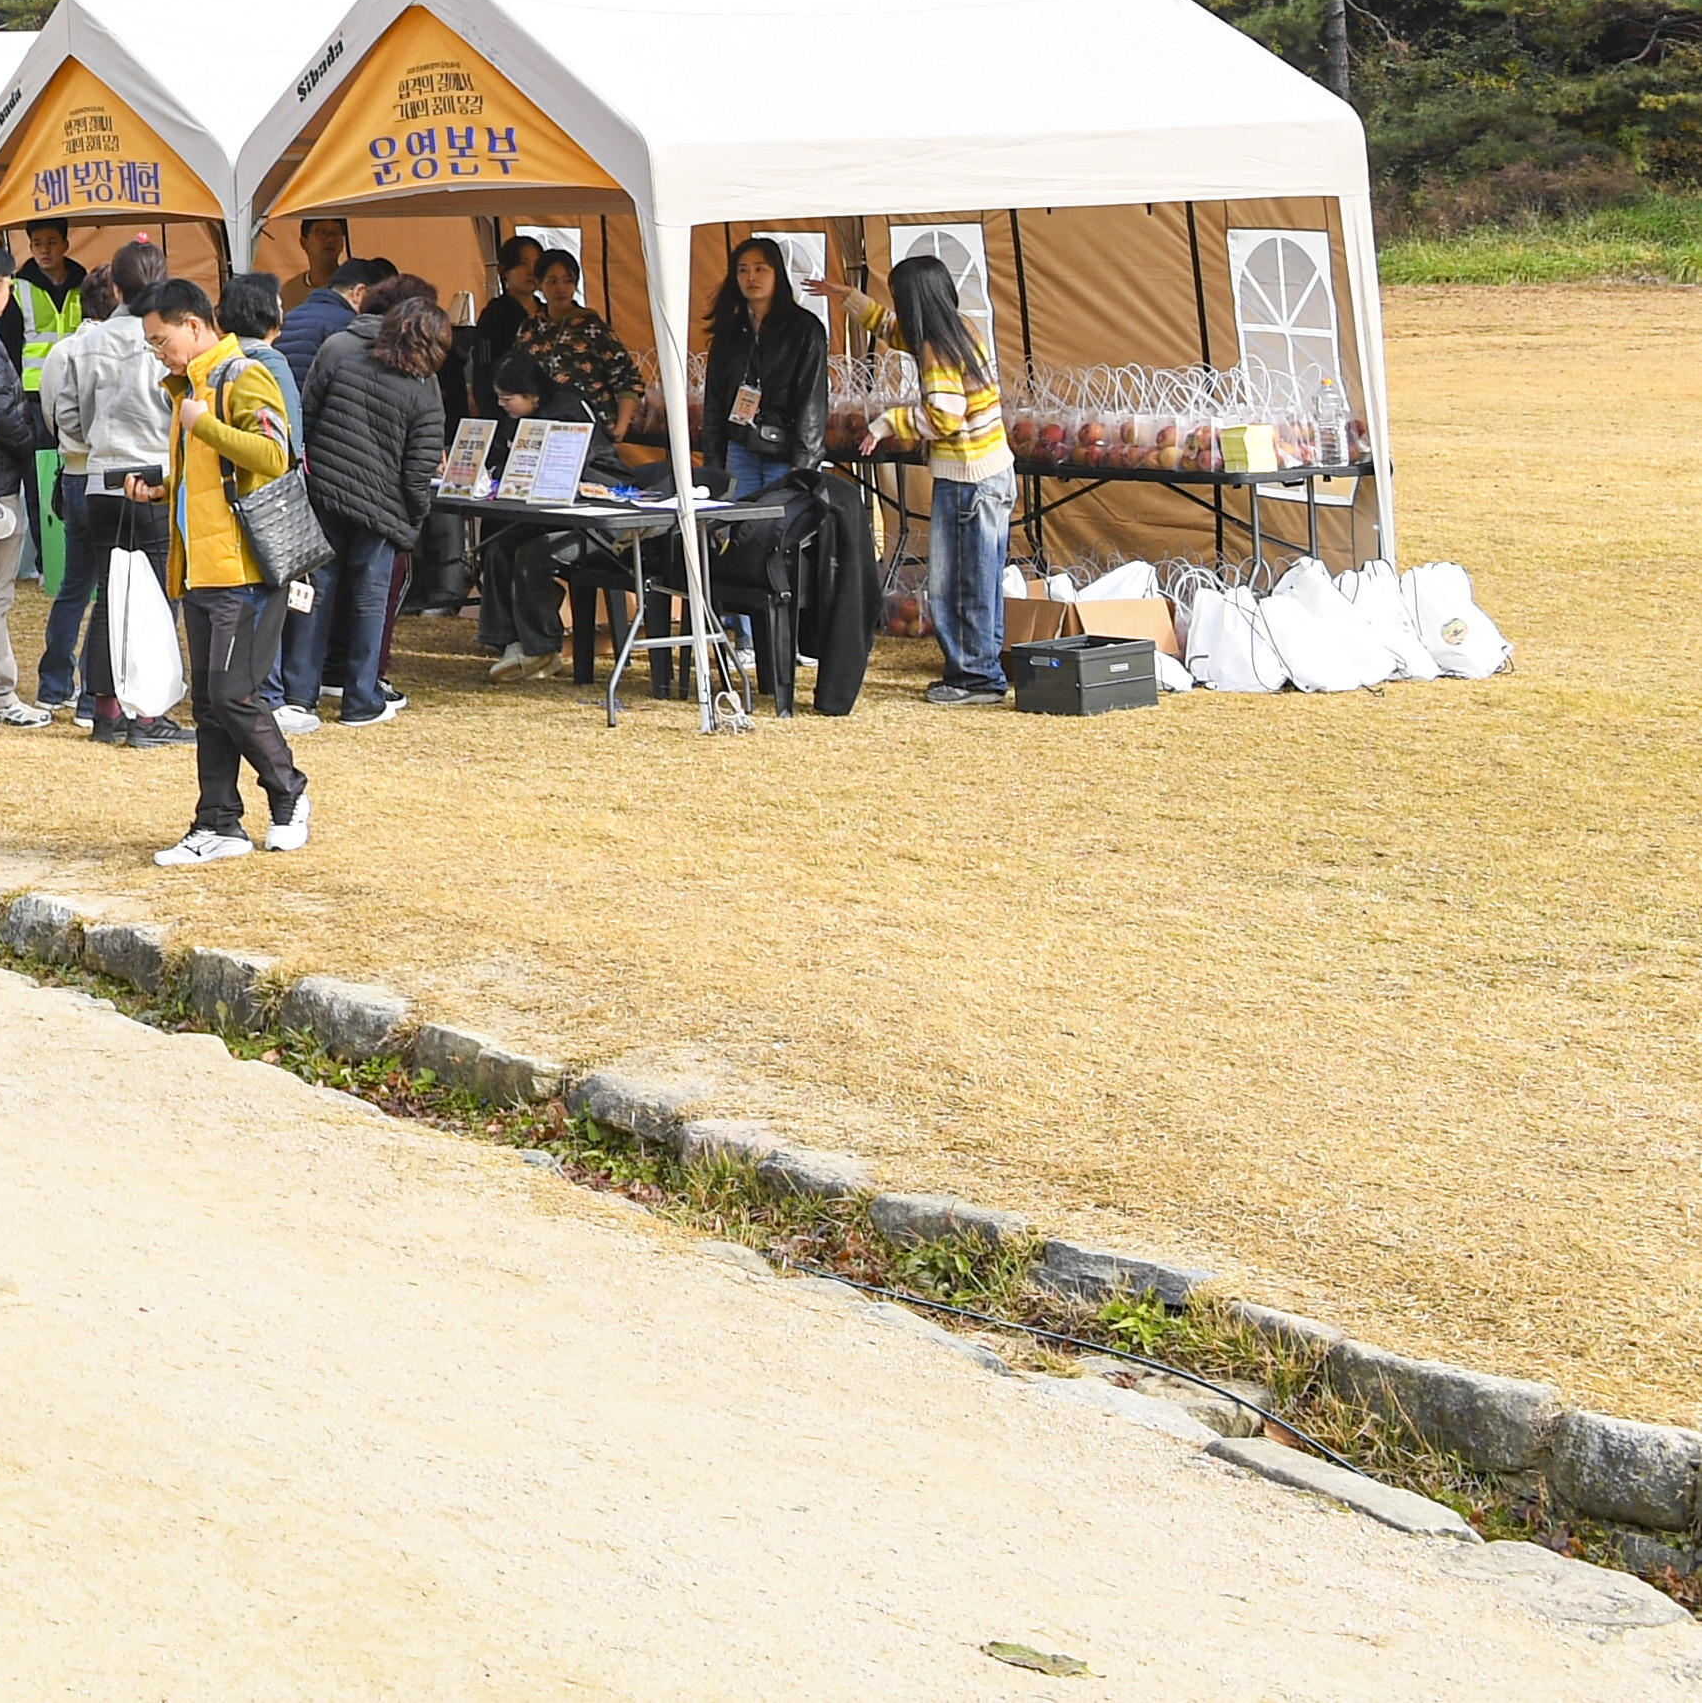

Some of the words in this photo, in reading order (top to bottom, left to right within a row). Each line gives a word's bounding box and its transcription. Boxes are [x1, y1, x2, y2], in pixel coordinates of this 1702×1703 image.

[297, 40, 344, 103] Sibada
[398, 75, 434, 99] 합격의
[437, 73, 474, 92] 길에서
[393, 98, 429, 123] 그대의
[432, 96, 456, 115] 꿈이
[369, 126, 519, 186] 운영본부
[32, 165, 70, 211] 선비
[73, 160, 114, 202] 복장
[116, 160, 160, 205] 체험
